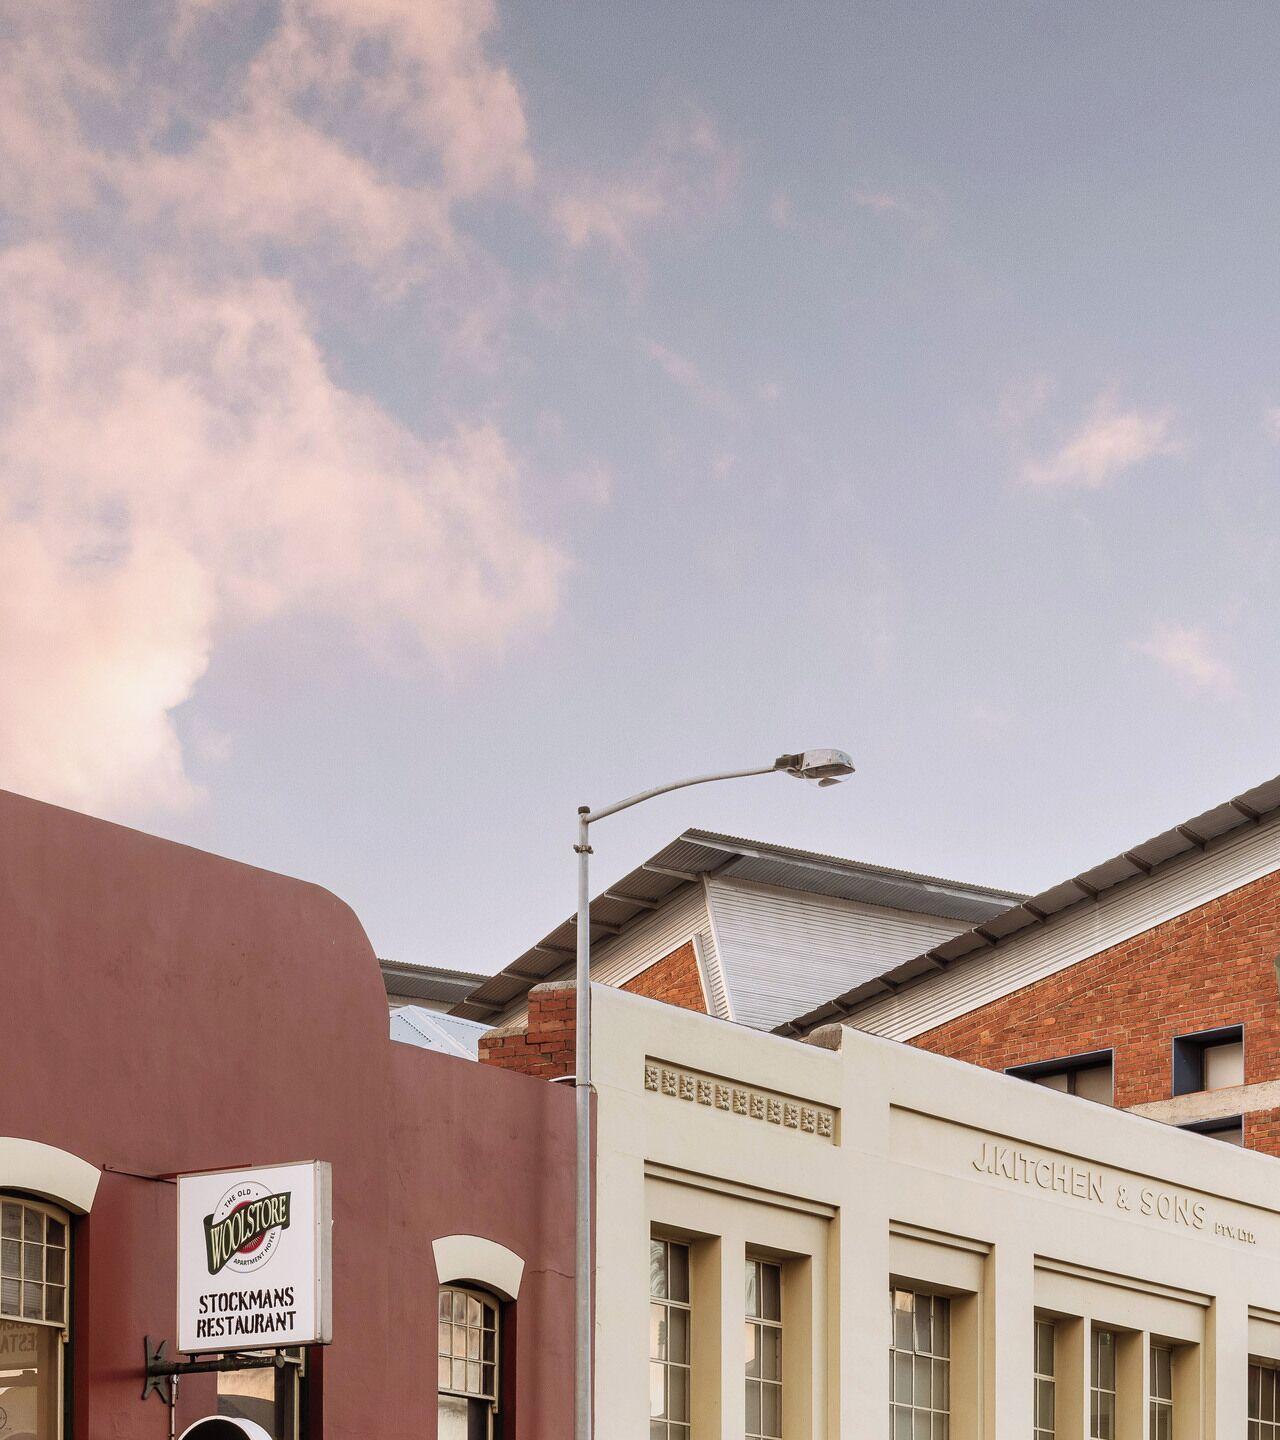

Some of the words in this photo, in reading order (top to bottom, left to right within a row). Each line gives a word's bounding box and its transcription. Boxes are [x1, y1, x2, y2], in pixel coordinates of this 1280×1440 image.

[224, 1195, 236, 1208] THE
[237, 1188, 252, 1197] OLD
[1116, 1184, 1131, 1211] &
[1140, 1187, 1205, 1229] SONS
[210, 1195, 287, 1271] WOOLSTORE
[233, 1252, 265, 1266] APARTMENT
[264, 1231, 276, 1253] HOTEL
[199, 1286, 294, 1314] STOCKMANS
[196, 1310, 297, 1338] RESTAURANT
